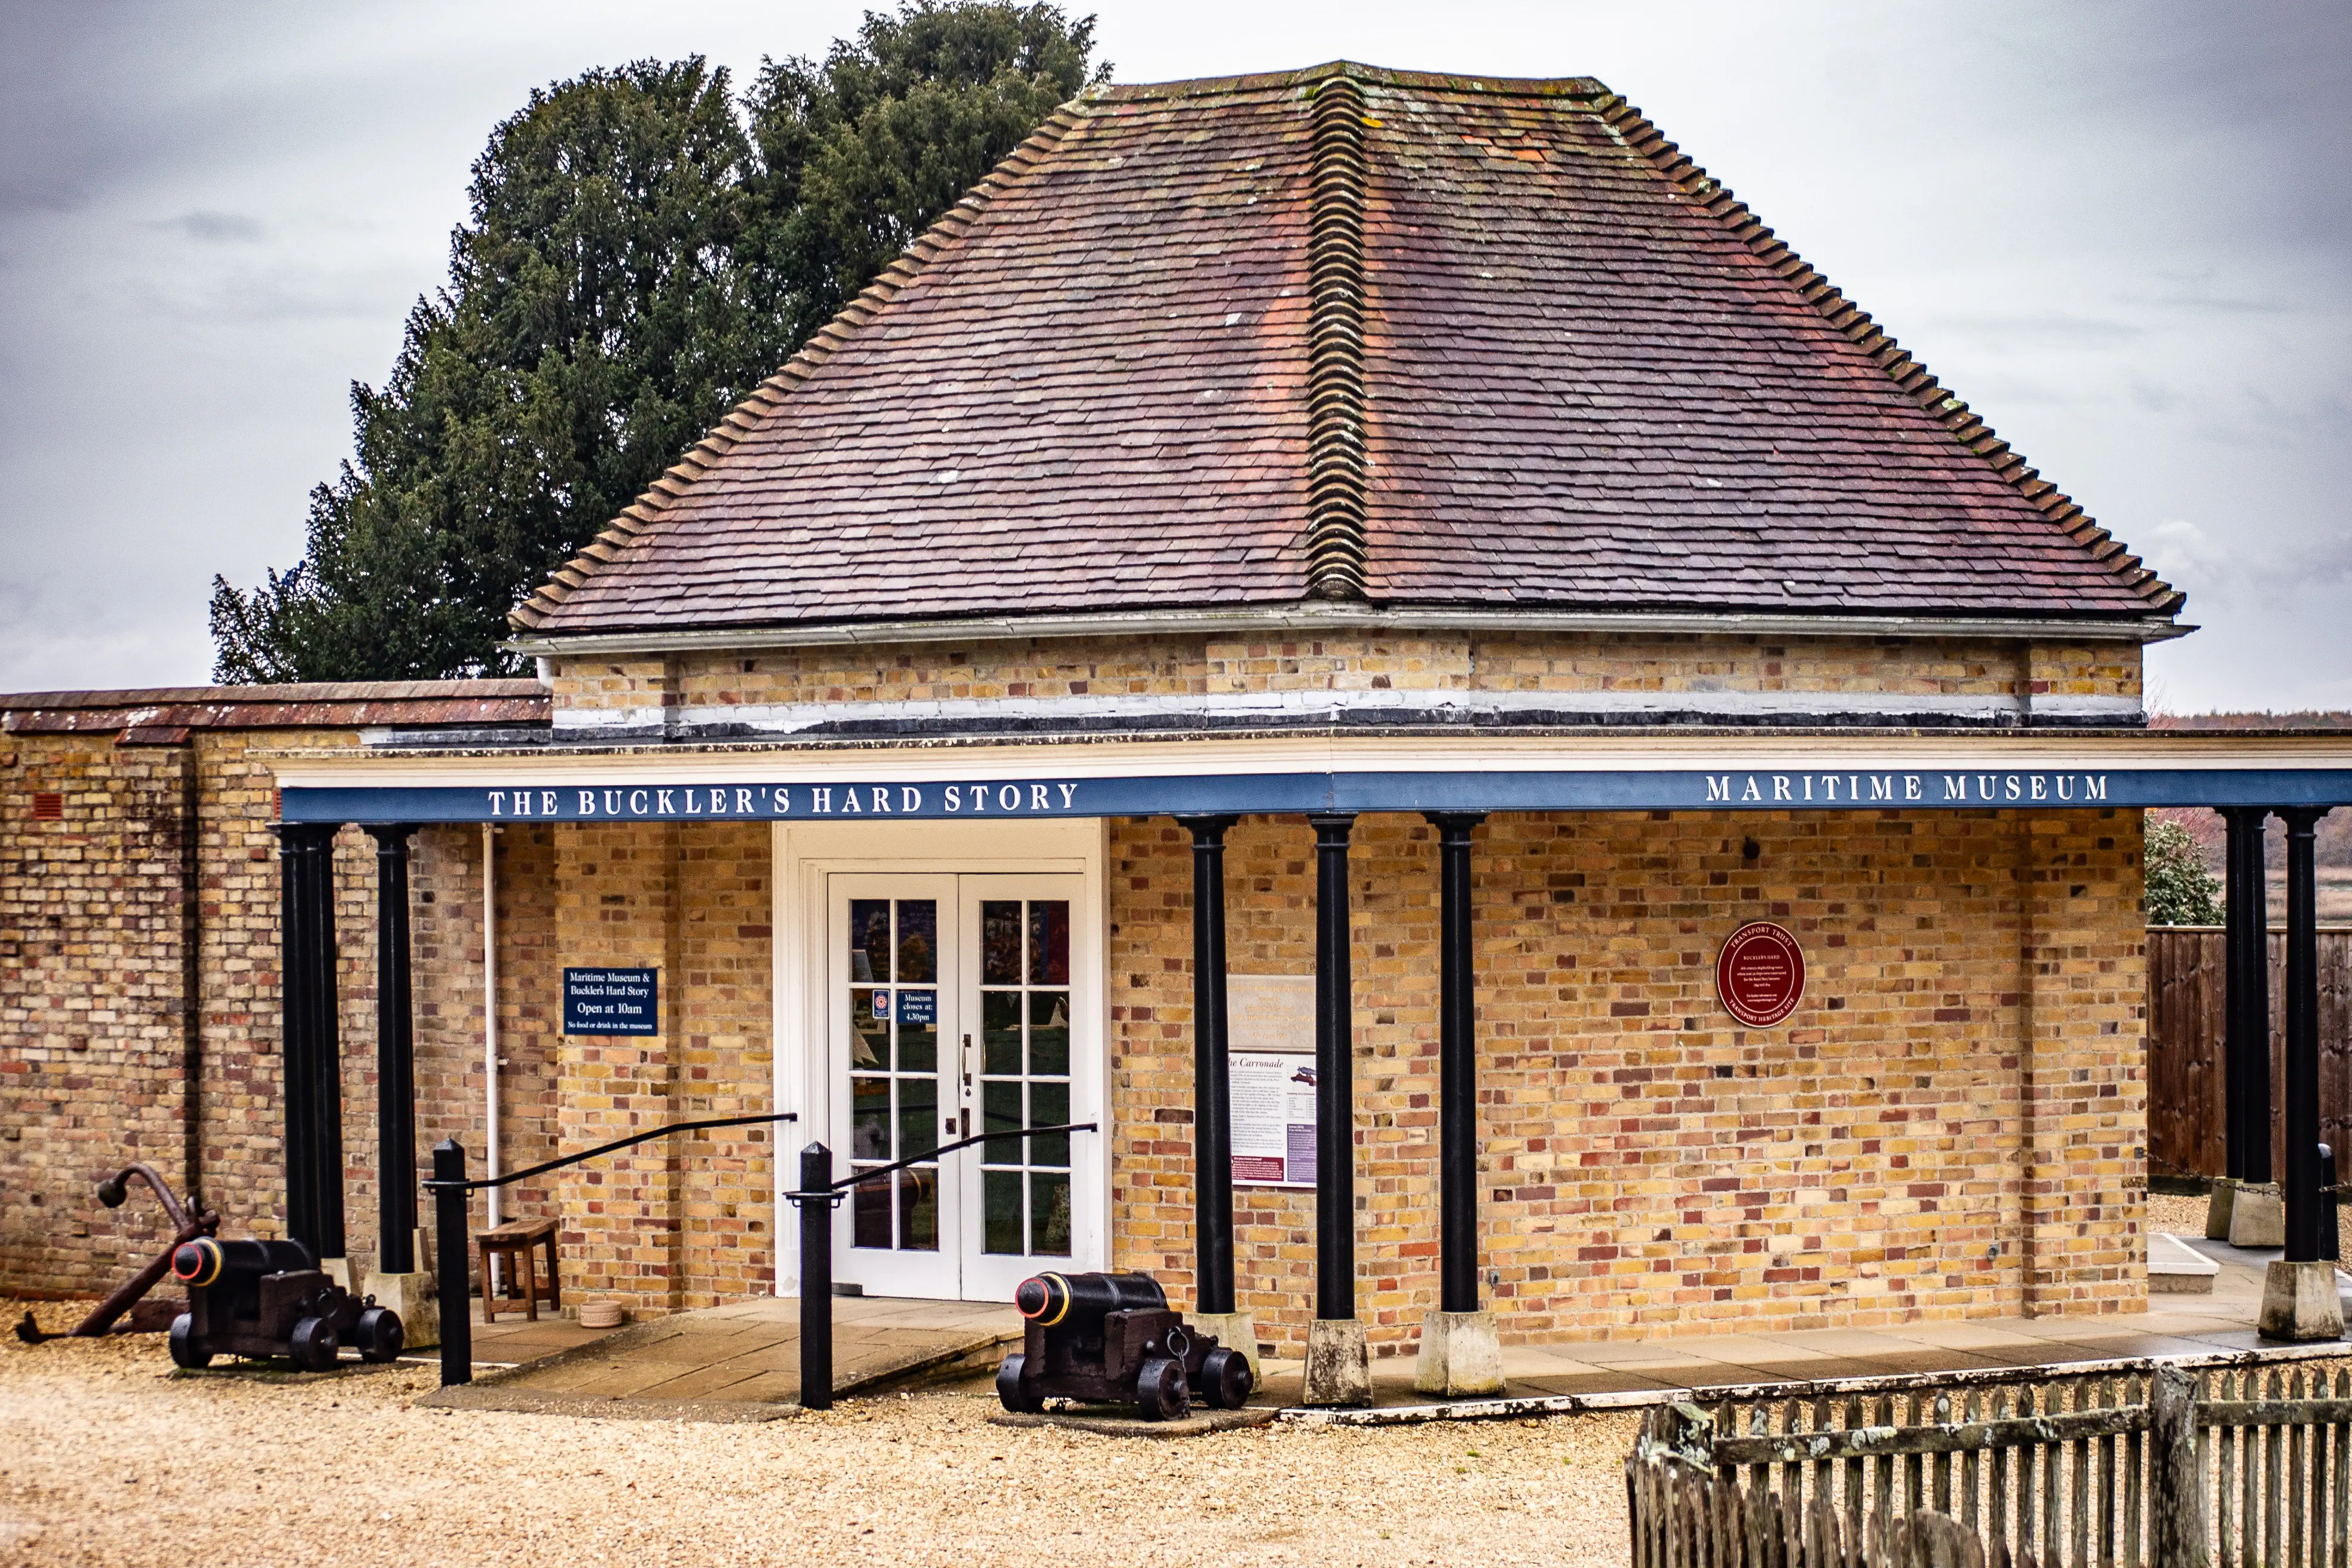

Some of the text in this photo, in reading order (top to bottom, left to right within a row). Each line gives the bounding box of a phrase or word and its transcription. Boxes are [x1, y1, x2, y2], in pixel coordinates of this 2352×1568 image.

[1705, 775, 2107, 801] MARITIME MUSEUM
[488, 783, 1077, 816] THE BUCKLER'S HARD STORY
[1731, 926, 1793, 948] TRANSPORT TRUST
[569, 972, 650, 983] Maritime Museum &
[571, 985, 650, 998] Buckler's Hard Story
[905, 994, 932, 1002] Museum
[577, 1002, 642, 1016] Open at 10am
[1729, 997, 1794, 1022] TRANSPORT HERITAGE SITE
[906, 1013, 930, 1022] 4.30pm
[1228, 1056, 1284, 1068] he Carronade
